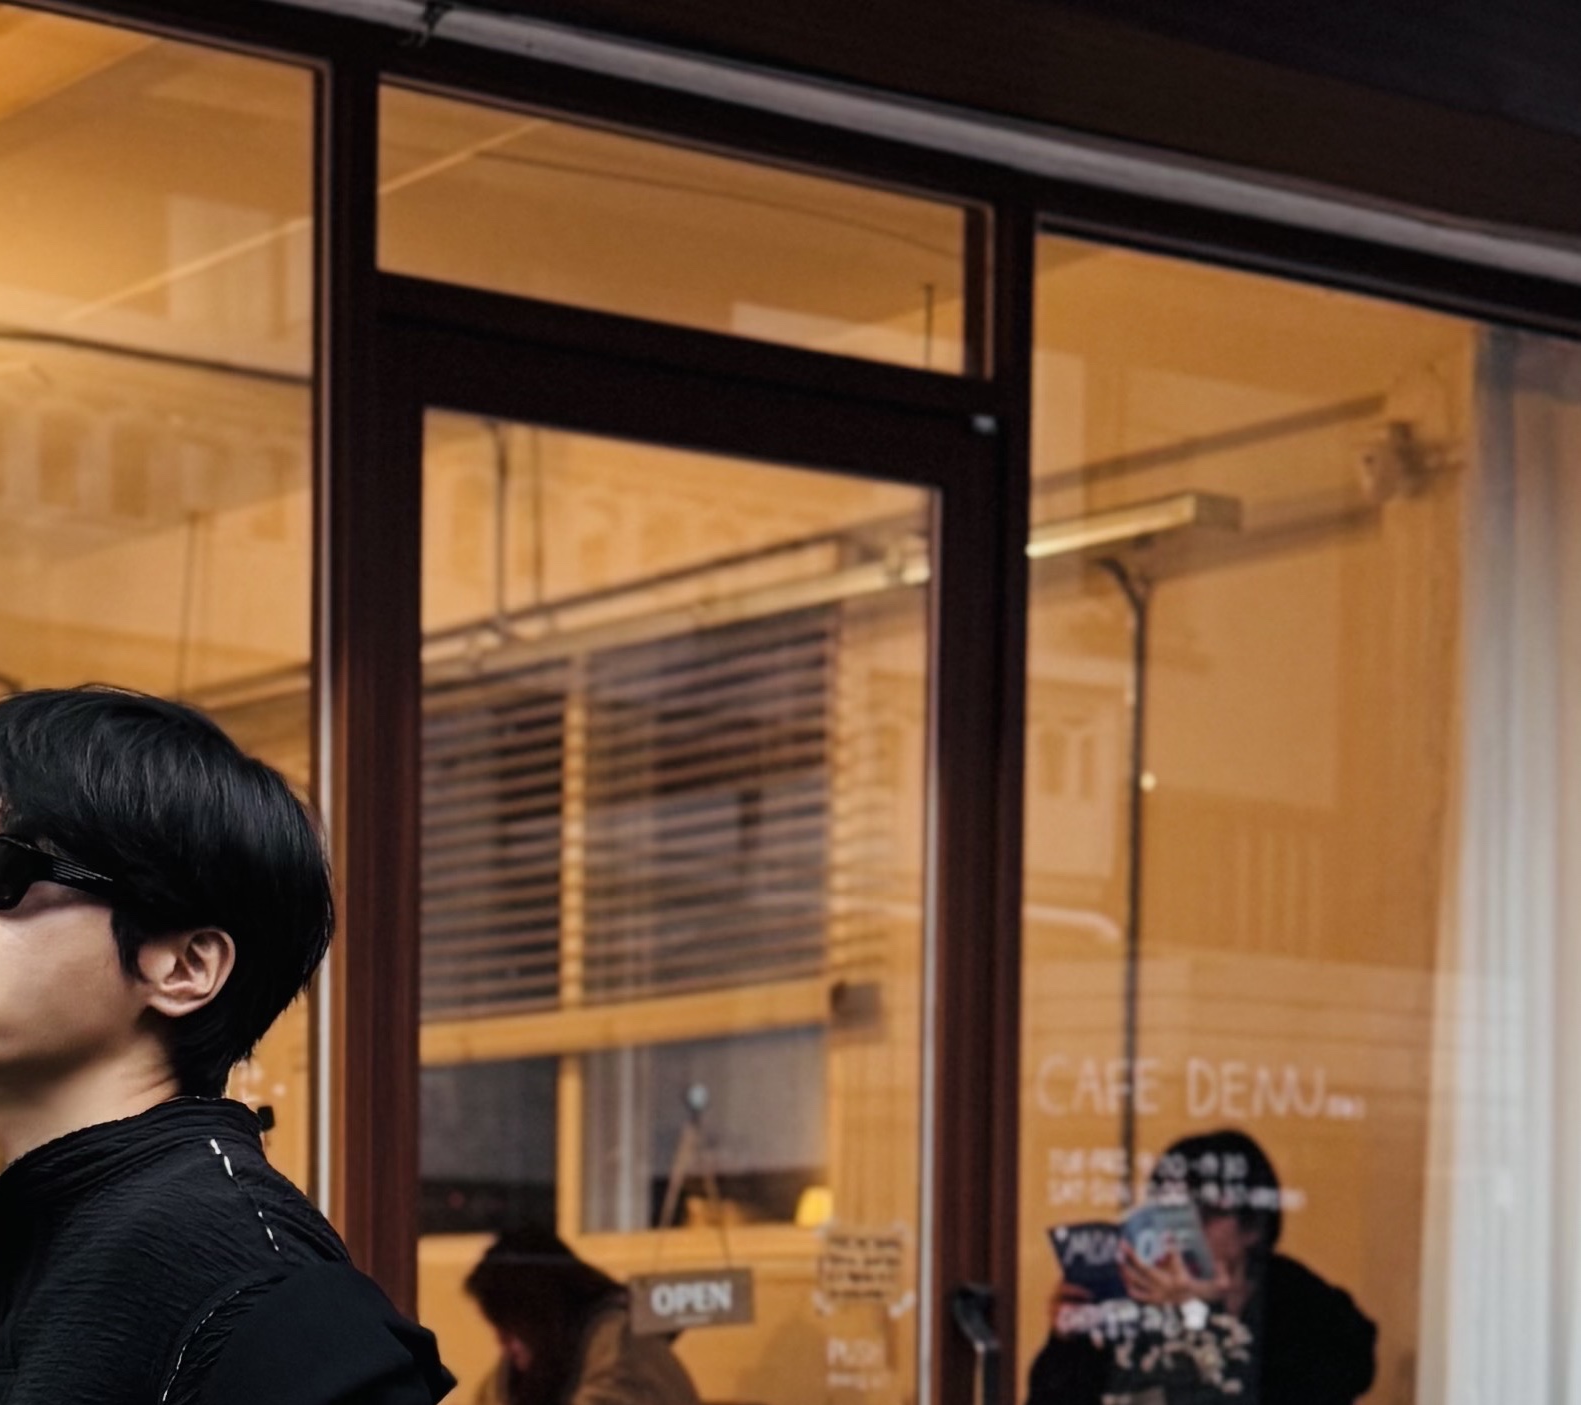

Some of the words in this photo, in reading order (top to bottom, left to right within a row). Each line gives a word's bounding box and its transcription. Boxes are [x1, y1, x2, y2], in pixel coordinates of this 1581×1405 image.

[1036, 1054, 1160, 1116] CAFE
[1186, 1056, 1325, 1119] DENU
[651, 1279, 732, 1316] OPEN
